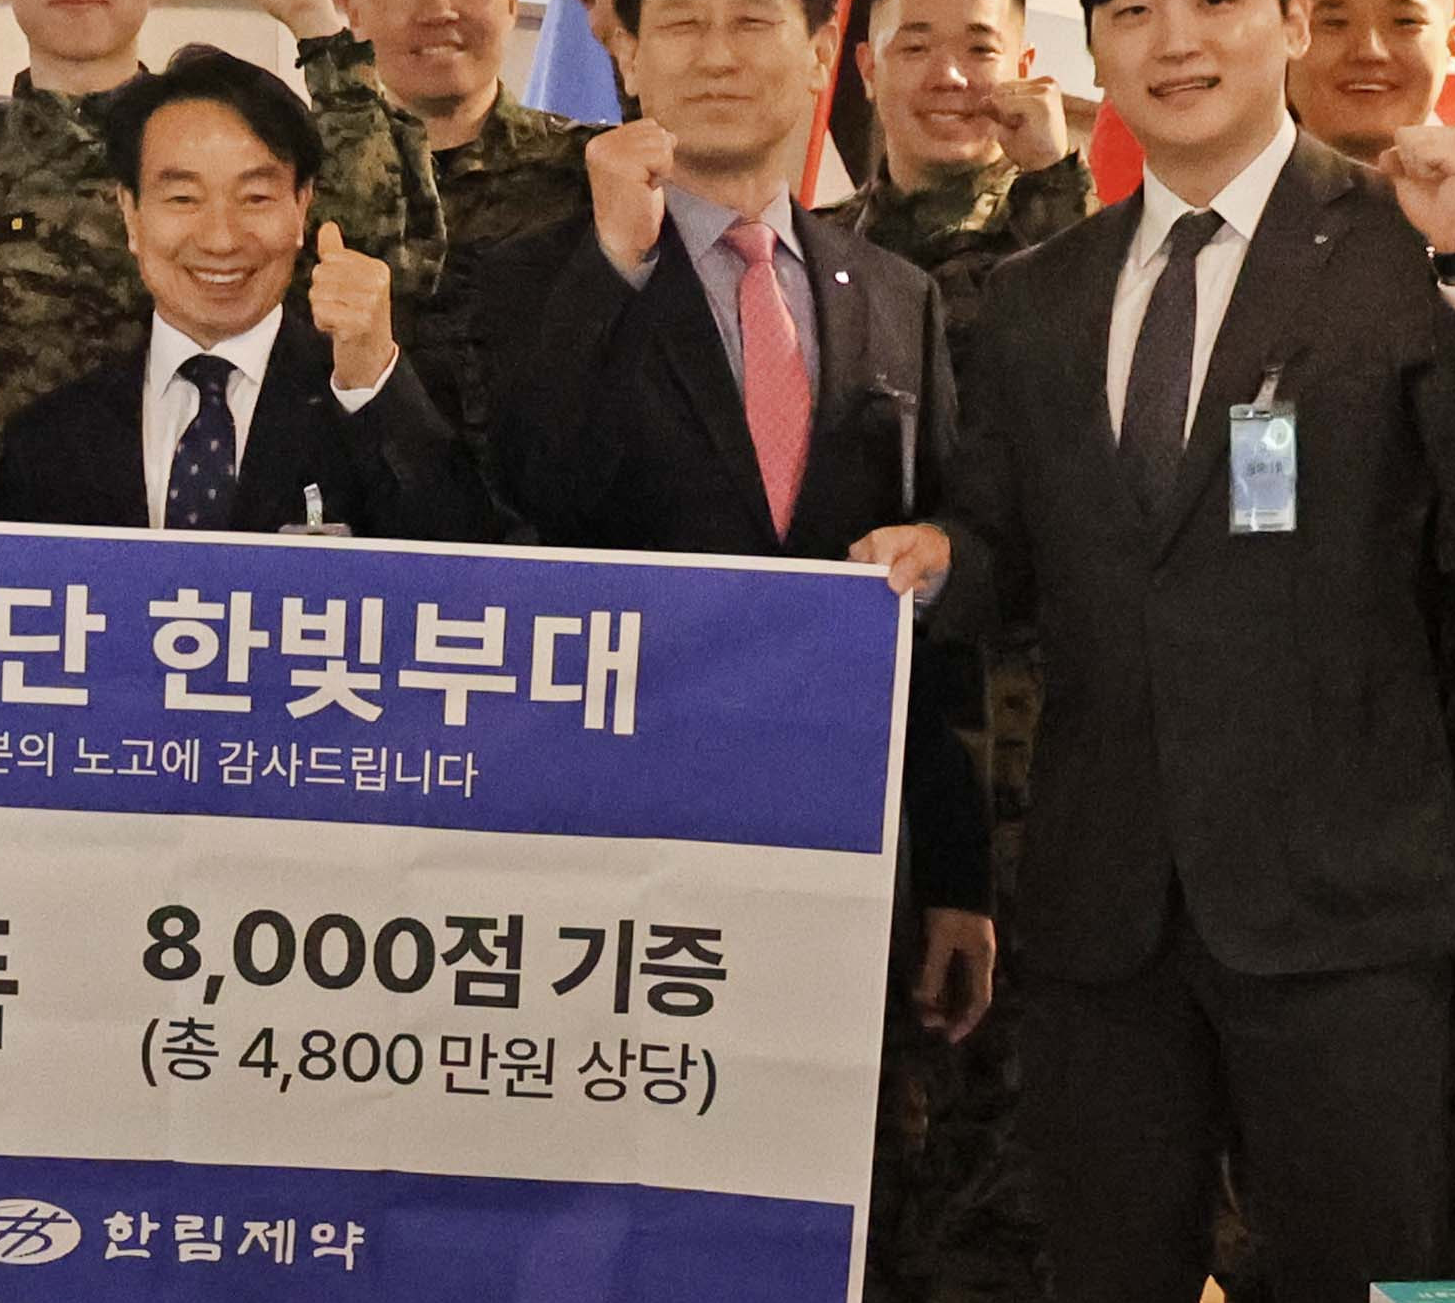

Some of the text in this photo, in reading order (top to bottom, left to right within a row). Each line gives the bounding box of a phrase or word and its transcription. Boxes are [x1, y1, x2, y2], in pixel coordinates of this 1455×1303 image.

[148, 588, 642, 735] 한빛부대
[73, 736, 201, 784] 노고에
[217, 740, 479, 798] 감사드립니다
[142, 905, 728, 1018] 8,000점 기증
[140, 1017, 718, 1117] (총 4,800 만원 상당)
[102, 1210, 366, 1271] 한림제약
